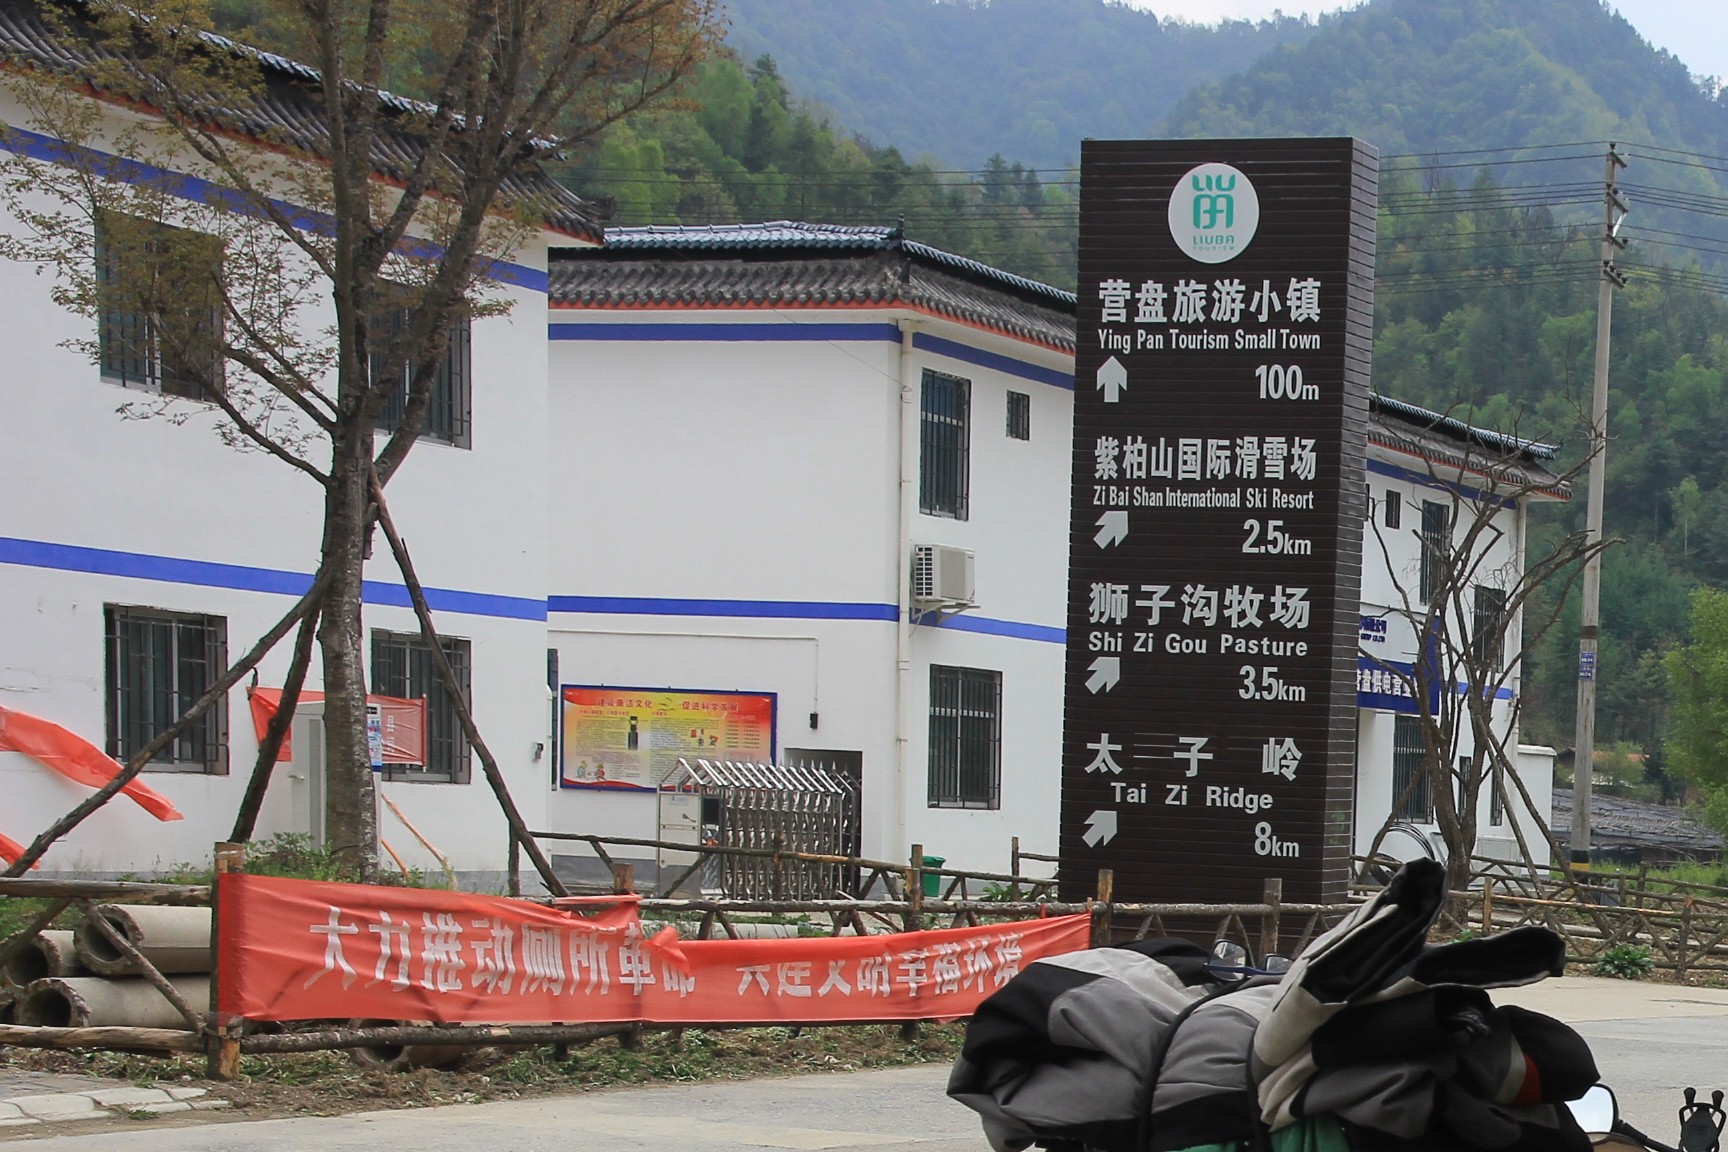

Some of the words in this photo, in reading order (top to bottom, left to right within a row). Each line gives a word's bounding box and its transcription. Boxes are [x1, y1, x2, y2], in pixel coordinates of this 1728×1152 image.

[1099, 278, 1321, 324] 营盘旅游小镇
[1098, 329, 1131, 354] Ying
[1137, 329, 1163, 350] Pan
[1170, 329, 1229, 350] Tourism
[1235, 329, 1276, 350] Small
[1280, 330, 1321, 350] Town
[1255, 364, 1320, 401] 100m
[1094, 436, 1316, 481] 紫柏山国际滑雪场
[1093, 485, 1106, 505] Zi
[1109, 485, 1129, 506] Bai
[1133, 486, 1164, 508] Shan
[1165, 487, 1241, 508] International
[1246, 488, 1267, 508] Ski
[1272, 488, 1314, 509] Resort
[1242, 519, 1312, 555] 2.5km
[1089, 582, 1311, 629] 狮子沟牧场
[1089, 631, 1122, 652] Shi
[1133, 632, 1153, 653] Zi
[1165, 634, 1207, 654] Gou
[1220, 634, 1308, 656] Pasture
[1238, 665, 1306, 701] 3.5km
[1084, 733, 1303, 781] 太子岭
[1111, 782, 1146, 803] Tai
[1165, 784, 1188, 805] Zi
[1206, 786, 1273, 814] Ridge
[1254, 822, 1300, 857] 8km
